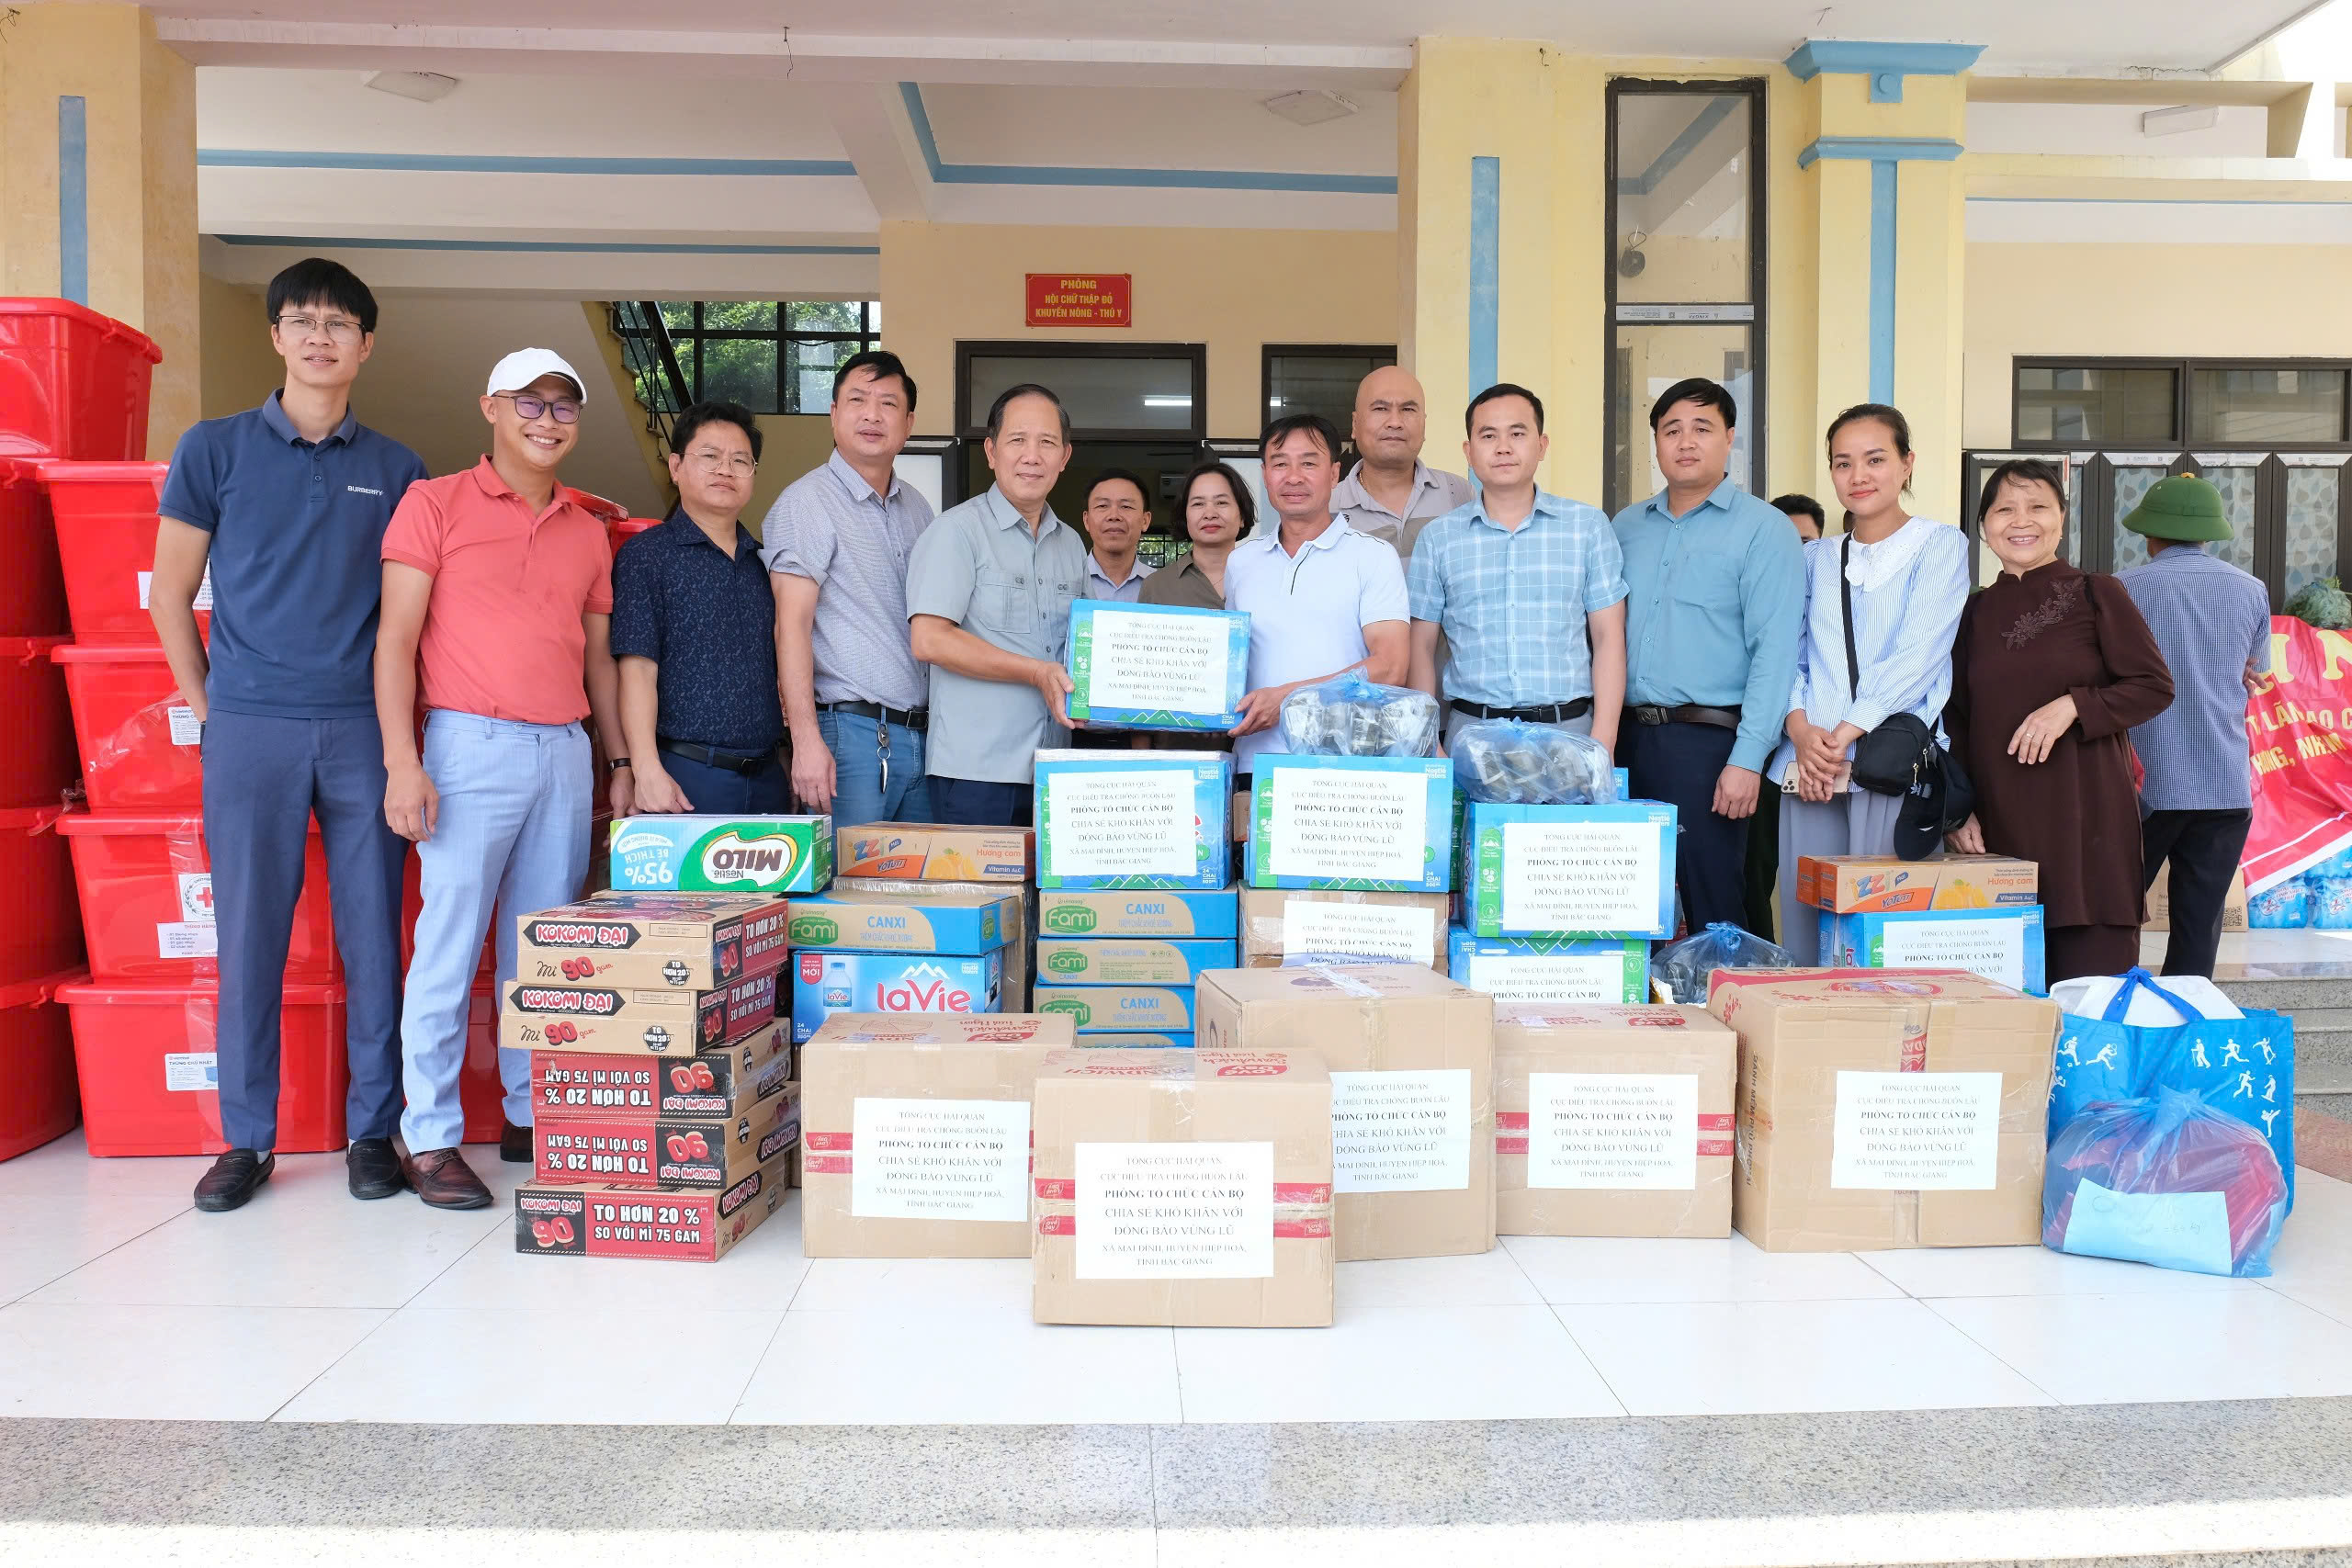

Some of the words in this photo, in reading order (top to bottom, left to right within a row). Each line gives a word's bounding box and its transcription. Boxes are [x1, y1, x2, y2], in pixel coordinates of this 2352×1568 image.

[1060, 278, 1097, 289] PHÒNG
[1046, 294, 1058, 305] HỘI
[1060, 293, 1077, 304] CHỮ
[1080, 294, 1100, 306] THẬP
[1102, 292, 1113, 304] ĐỎ
[1035, 306, 1068, 318] KHUYẾN
[1069, 307, 1091, 318] NÔNG
[1100, 307, 1115, 318] THÚ
[1117, 309, 1122, 318] Y
[347, 485, 384, 496] BURBERRY
[625, 850, 655, 864] THÍCH
[657, 849, 669, 861] BÉ
[713, 849, 783, 871] MILO
[977, 849, 1002, 858] Hương
[625, 861, 673, 886] 95%
[713, 869, 744, 879] Nestlé
[1987, 877, 2014, 886] Hương
[1126, 904, 1165, 915] CANXI
[867, 916, 906, 929] CANXI
[536, 924, 596, 943] KOKOMI
[597, 926, 628, 947] ĐẠI
[561, 956, 594, 982] 90
[802, 967, 820, 976] MỚI
[522, 989, 581, 1009] KOKOMI
[582, 992, 613, 1012] ĐẠI
[877, 980, 971, 1012] laVie
[1121, 998, 1159, 1009] CANXI
[544, 1021, 578, 1046] 90
[545, 1069, 571, 1082] GAM
[575, 1070, 589, 1083] 75
[593, 1070, 606, 1085] MÌ
[610, 1070, 630, 1086] VỚI
[634, 1071, 650, 1083] SO
[670, 1061, 714, 1093] 90
[545, 1088, 560, 1104] %
[566, 1088, 587, 1106] 20
[592, 1089, 625, 1106] HƠN
[628, 1089, 651, 1107] TO
[663, 1097, 684, 1110] ĐẠI
[685, 1099, 726, 1110] KOKOMI
[547, 1134, 571, 1148] GAM
[575, 1135, 589, 1149] 75
[592, 1136, 605, 1152] MÌ
[609, 1137, 628, 1154] VỚI
[632, 1138, 648, 1152] SO
[666, 1131, 709, 1162] 90
[548, 1152, 562, 1169] %
[568, 1154, 587, 1171] 20
[591, 1155, 624, 1172] HƠN
[628, 1157, 649, 1174] TO
[661, 1166, 680, 1179] ĐẠI
[681, 1168, 720, 1180] KOKOMI
[520, 1198, 560, 1211] KOKOMI
[560, 1199, 582, 1213] ĐẠI
[594, 1205, 616, 1222] TO
[620, 1204, 653, 1224] HƠN
[658, 1207, 680, 1224] 20
[684, 1209, 700, 1224] %
[532, 1216, 576, 1247] 90
[595, 1226, 610, 1240] SO
[616, 1225, 635, 1241] VỚI
[639, 1226, 653, 1241] MÌ
[657, 1228, 671, 1242] 75
[674, 1229, 700, 1243] GAM
